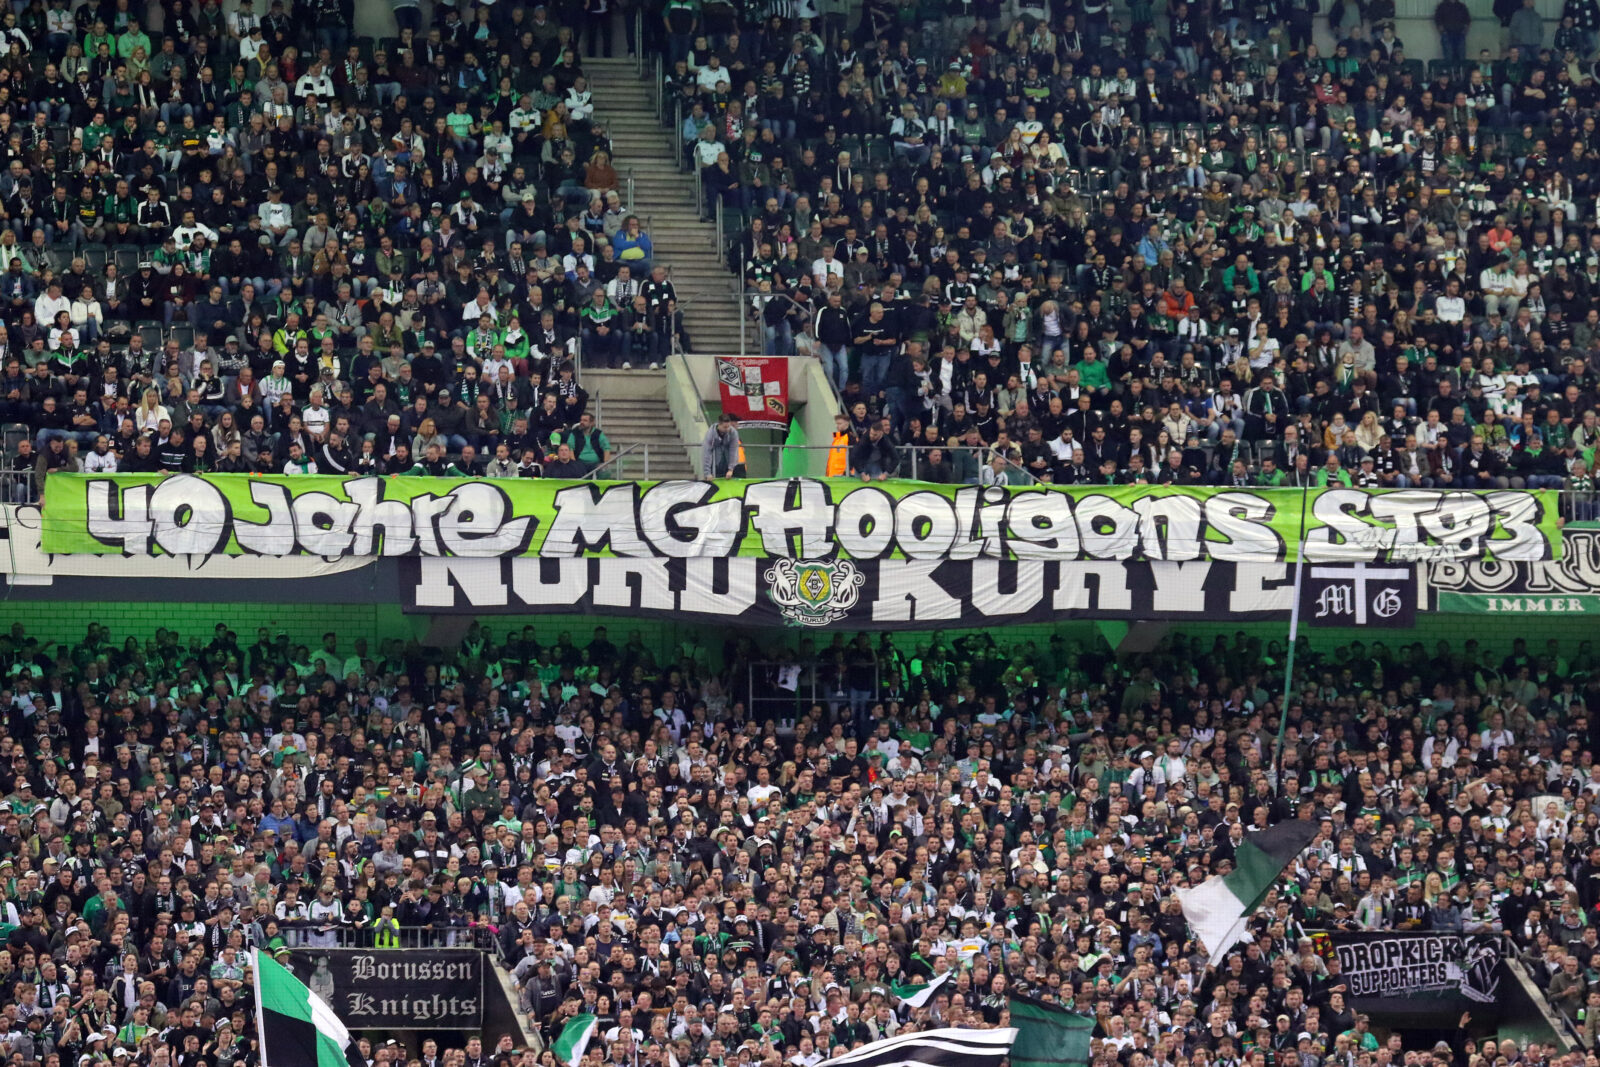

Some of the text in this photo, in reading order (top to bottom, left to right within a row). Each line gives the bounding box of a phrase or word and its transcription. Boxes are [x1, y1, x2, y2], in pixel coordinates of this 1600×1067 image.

[86, 474, 233, 555] 40
[233, 476, 539, 558] Jahre
[1487, 598, 1585, 612] IMMER
[351, 955, 473, 983] Borussen
[1337, 936, 1463, 974] DROPKICK
[1350, 961, 1449, 996] SUPPORTERS
[346, 992, 477, 1020] Knights
